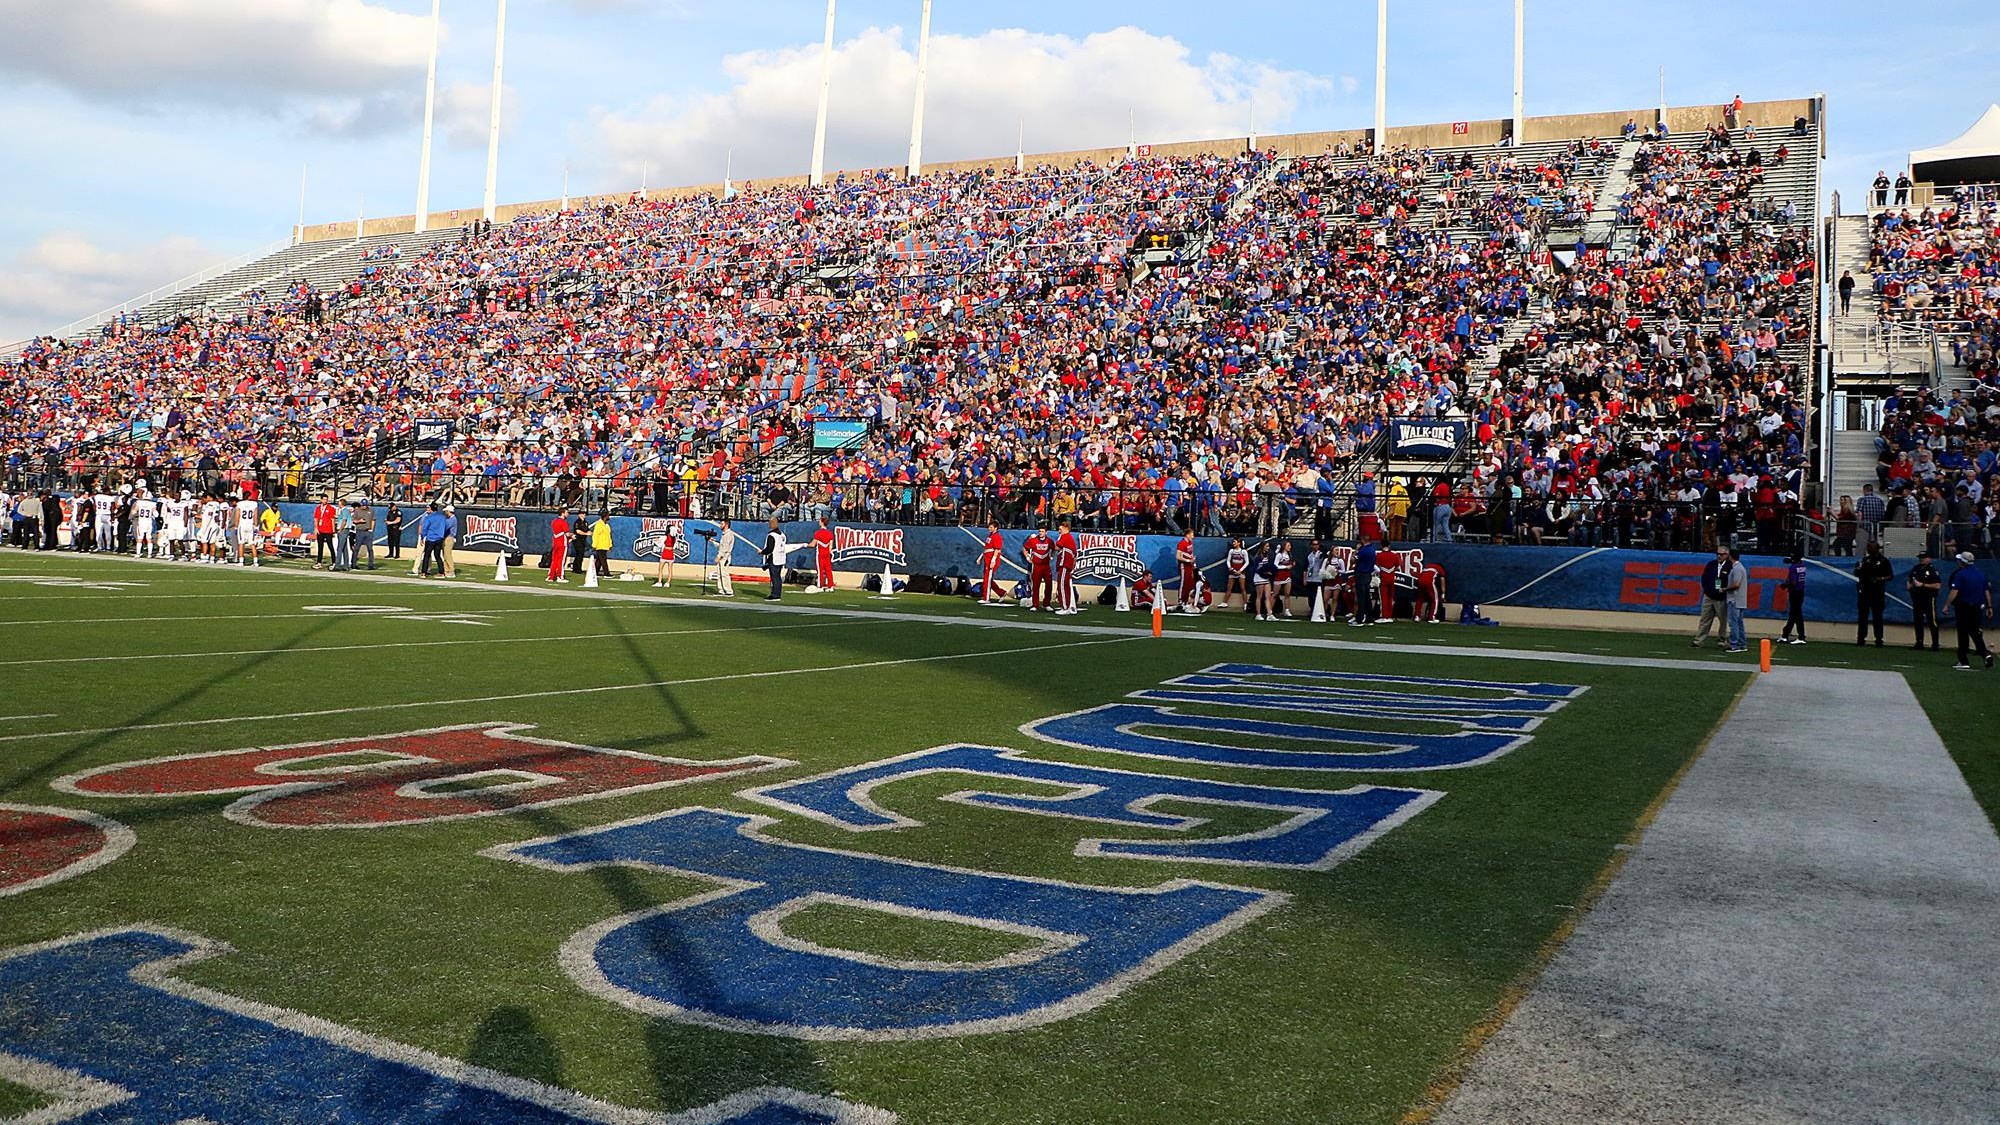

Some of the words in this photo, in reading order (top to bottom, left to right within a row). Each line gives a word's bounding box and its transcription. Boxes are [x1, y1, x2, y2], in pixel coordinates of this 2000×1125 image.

[1533, 251, 1548, 264] 117
[1163, 266, 1175, 277] 117
[1102, 273, 1115, 284] 116
[97, 501, 108, 510] 99
[140, 509, 150, 518] 83
[241, 510, 253, 519] 20
[1075, 557, 1143, 575] NDEPENDENCE
[1095, 566, 1118, 575] BOWL
[1619, 561, 1790, 613] ESN
